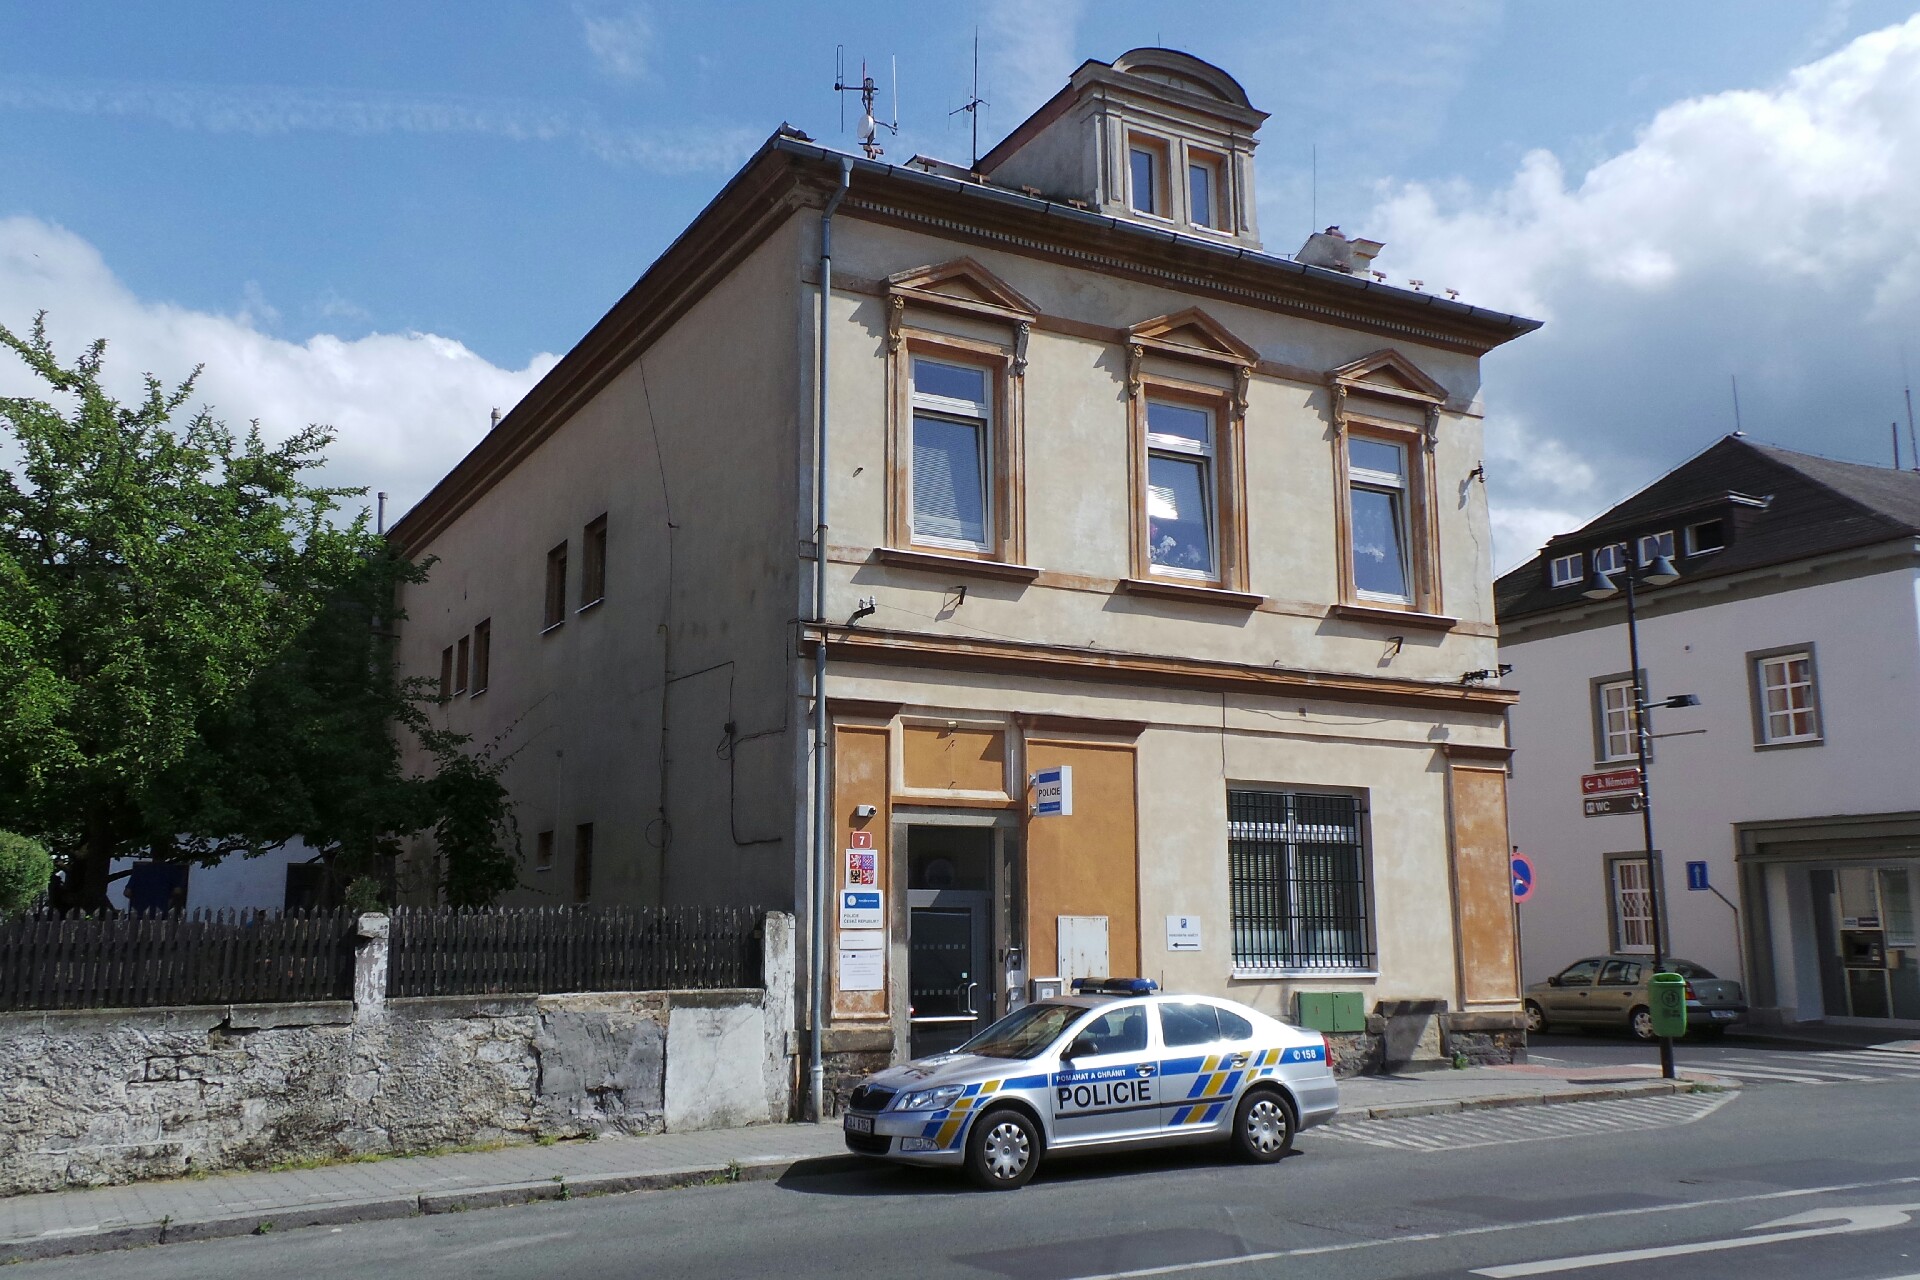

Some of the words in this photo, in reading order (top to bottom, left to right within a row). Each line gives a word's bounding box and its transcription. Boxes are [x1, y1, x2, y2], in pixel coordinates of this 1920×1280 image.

[1038, 787, 1060, 798] POLICIE
[1595, 801, 1610, 812] WC
[859, 836, 865, 846] 7
[1301, 1049, 1316, 1059] 158
[1090, 1072, 1096, 1080] A
[1097, 1069, 1126, 1079] CHRÁNIT
[1058, 1080, 1151, 1110] POLICIE
